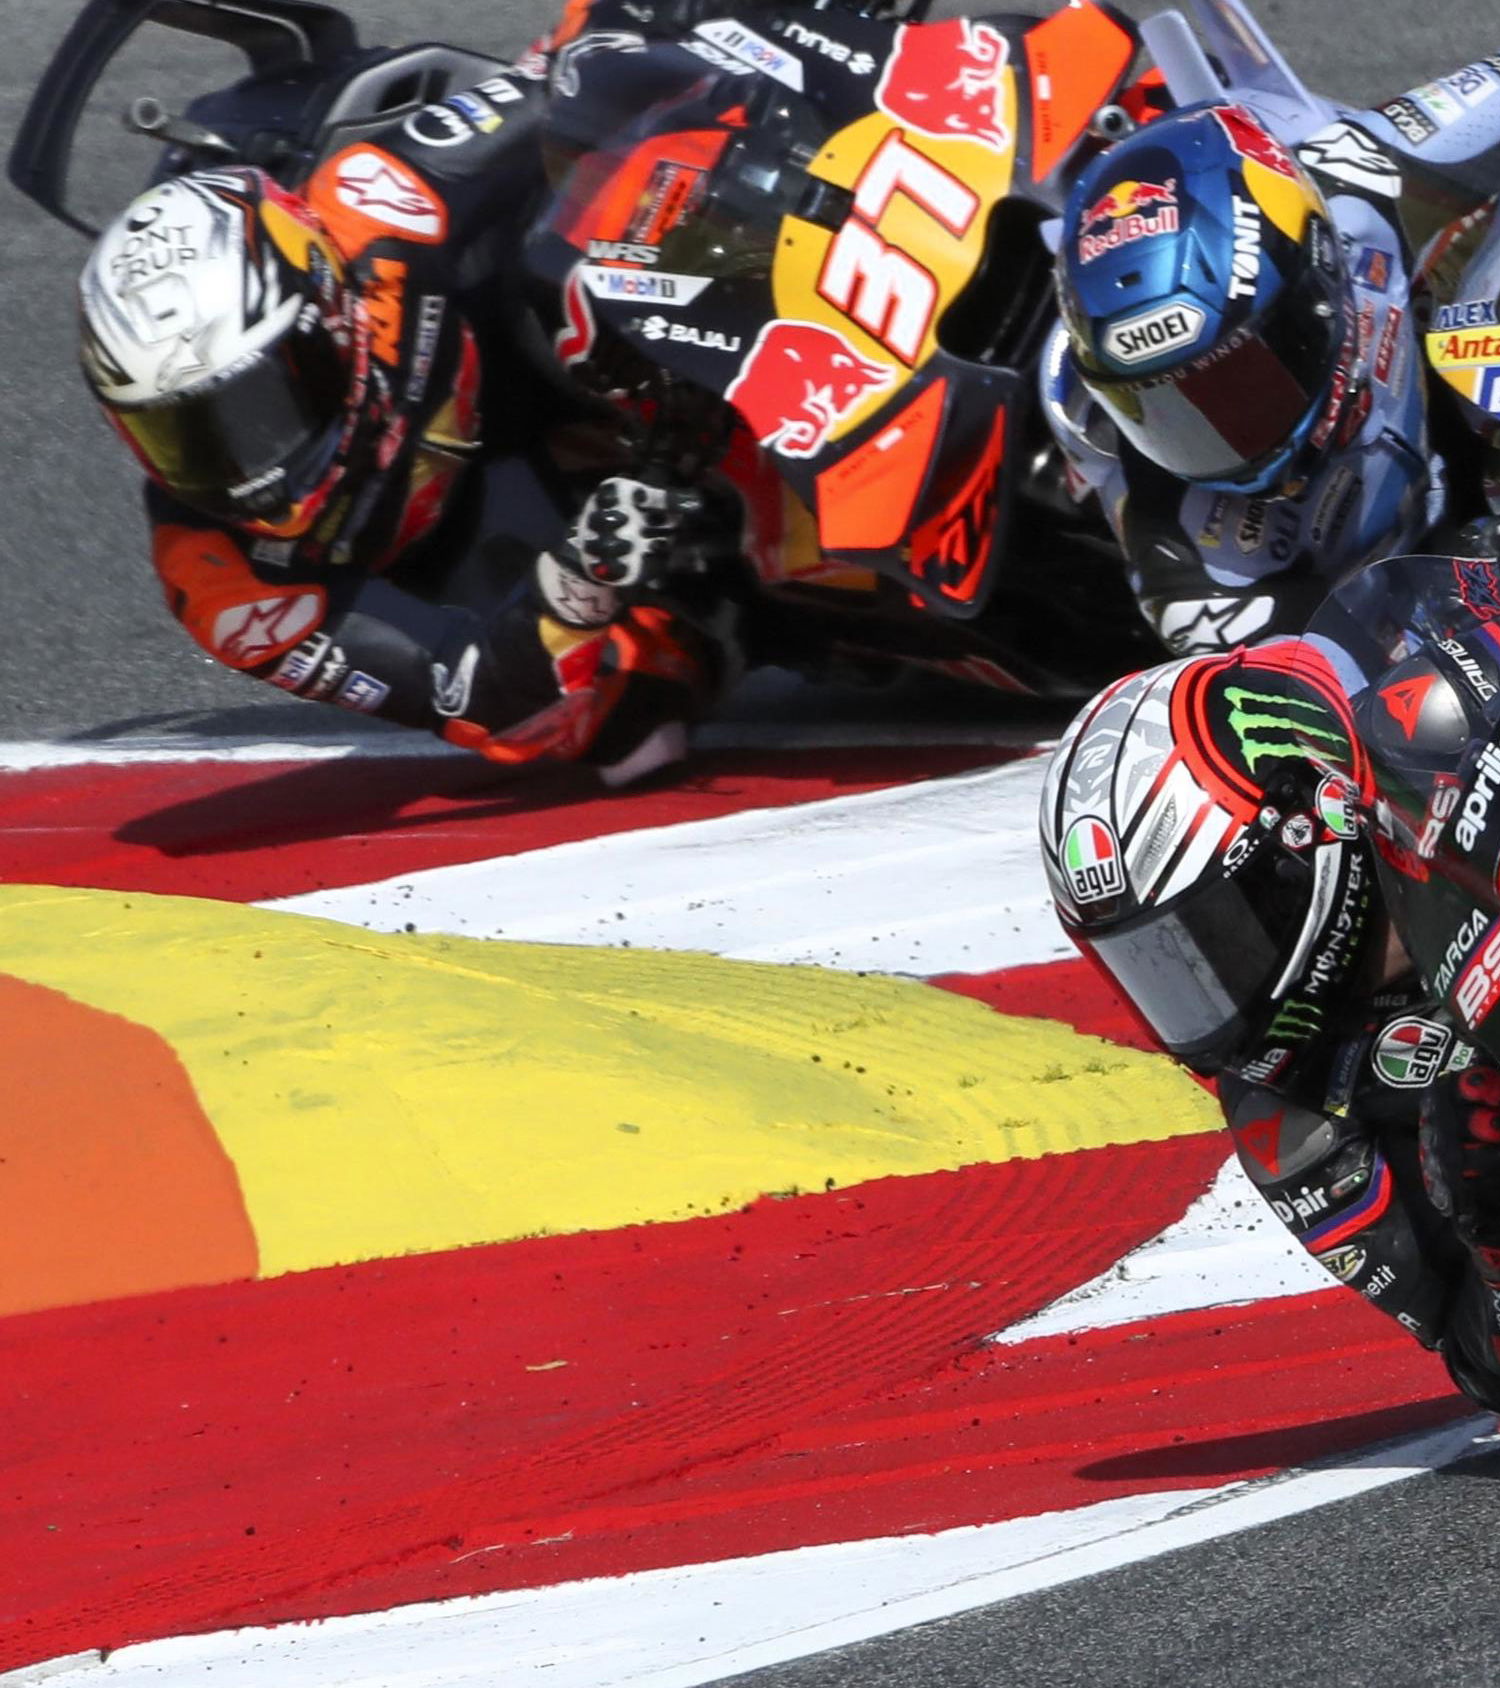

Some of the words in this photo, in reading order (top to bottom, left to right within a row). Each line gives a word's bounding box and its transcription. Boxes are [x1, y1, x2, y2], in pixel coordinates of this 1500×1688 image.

[816, 126, 981, 370] 37
[608, 273, 657, 296] Mobil
[668, 323, 741, 351] BAJAJ
[1116, 312, 1189, 355] SHOEI
[1435, 301, 1497, 330] ALEX
[1074, 861, 1116, 895] agv
[1304, 853, 1363, 994] MONSTER
[1433, 908, 1489, 998] TARGA
[1408, 1030, 1442, 1079] agv
